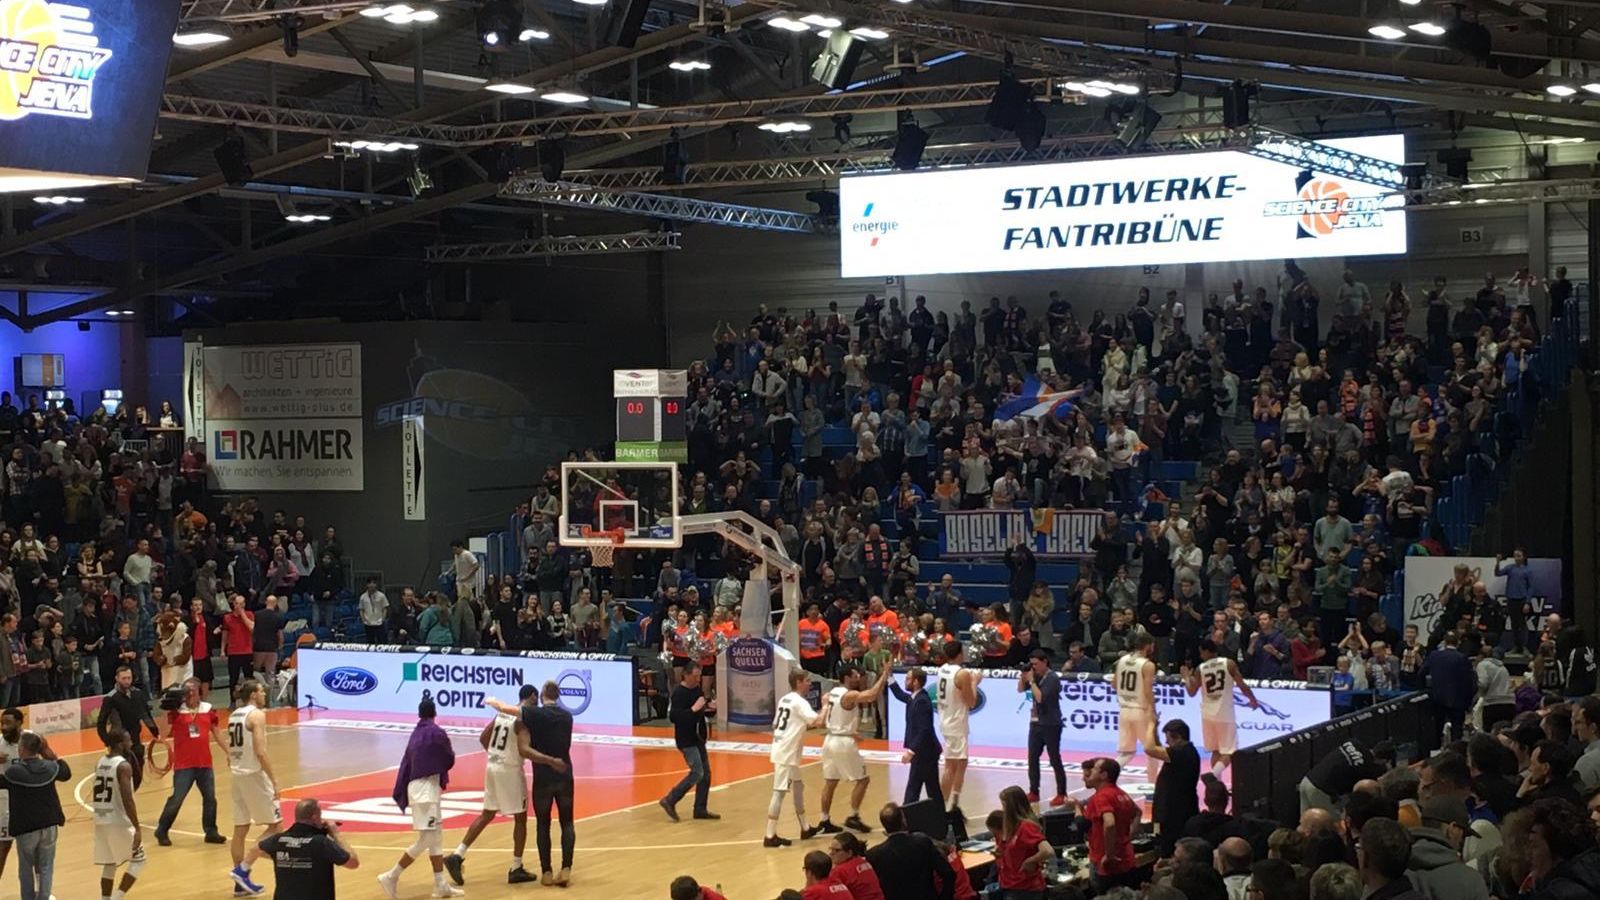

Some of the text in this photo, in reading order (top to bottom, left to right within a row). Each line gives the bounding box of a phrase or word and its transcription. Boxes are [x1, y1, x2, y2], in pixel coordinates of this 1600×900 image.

[38, 44, 106, 80] CITY
[17, 77, 89, 114] JENA
[1002, 175, 1246, 211] STADTWERKE-
[1263, 196, 1386, 217] SCIENCE CITY
[853, 220, 899, 235] energie
[1332, 212, 1384, 230] JENA
[1003, 213, 1224, 250] FANTRIBÜNE
[1462, 230, 1482, 243] B3
[243, 387, 292, 397] architekten
[304, 387, 353, 397] ingenieure
[240, 429, 353, 460] RAHMER
[616, 448, 658, 458] BARMER
[215, 466, 231, 476] Wir
[276, 466, 291, 476] Sie
[376, 644, 401, 652] OPITZ
[580, 652, 588, 660] &
[588, 652, 616, 661] OPITZ
[732, 647, 767, 657] SACHSEN
[734, 656, 765, 667] QUELLE
[331, 670, 367, 691] Ford
[992, 669, 1022, 679] OPITZ
[1120, 670, 1138, 692] 10
[1204, 670, 1226, 693] 23
[1261, 680, 1271, 688] &
[1272, 679, 1308, 689] OPITZ
[437, 689, 486, 709] OPITZ
[560, 688, 587, 697] VOLVO
[939, 678, 947, 700] 9
[1070, 709, 1120, 730] OPIT
[227, 723, 244, 747] 50
[491, 724, 509, 750] 13
[93, 776, 113, 803] 25
